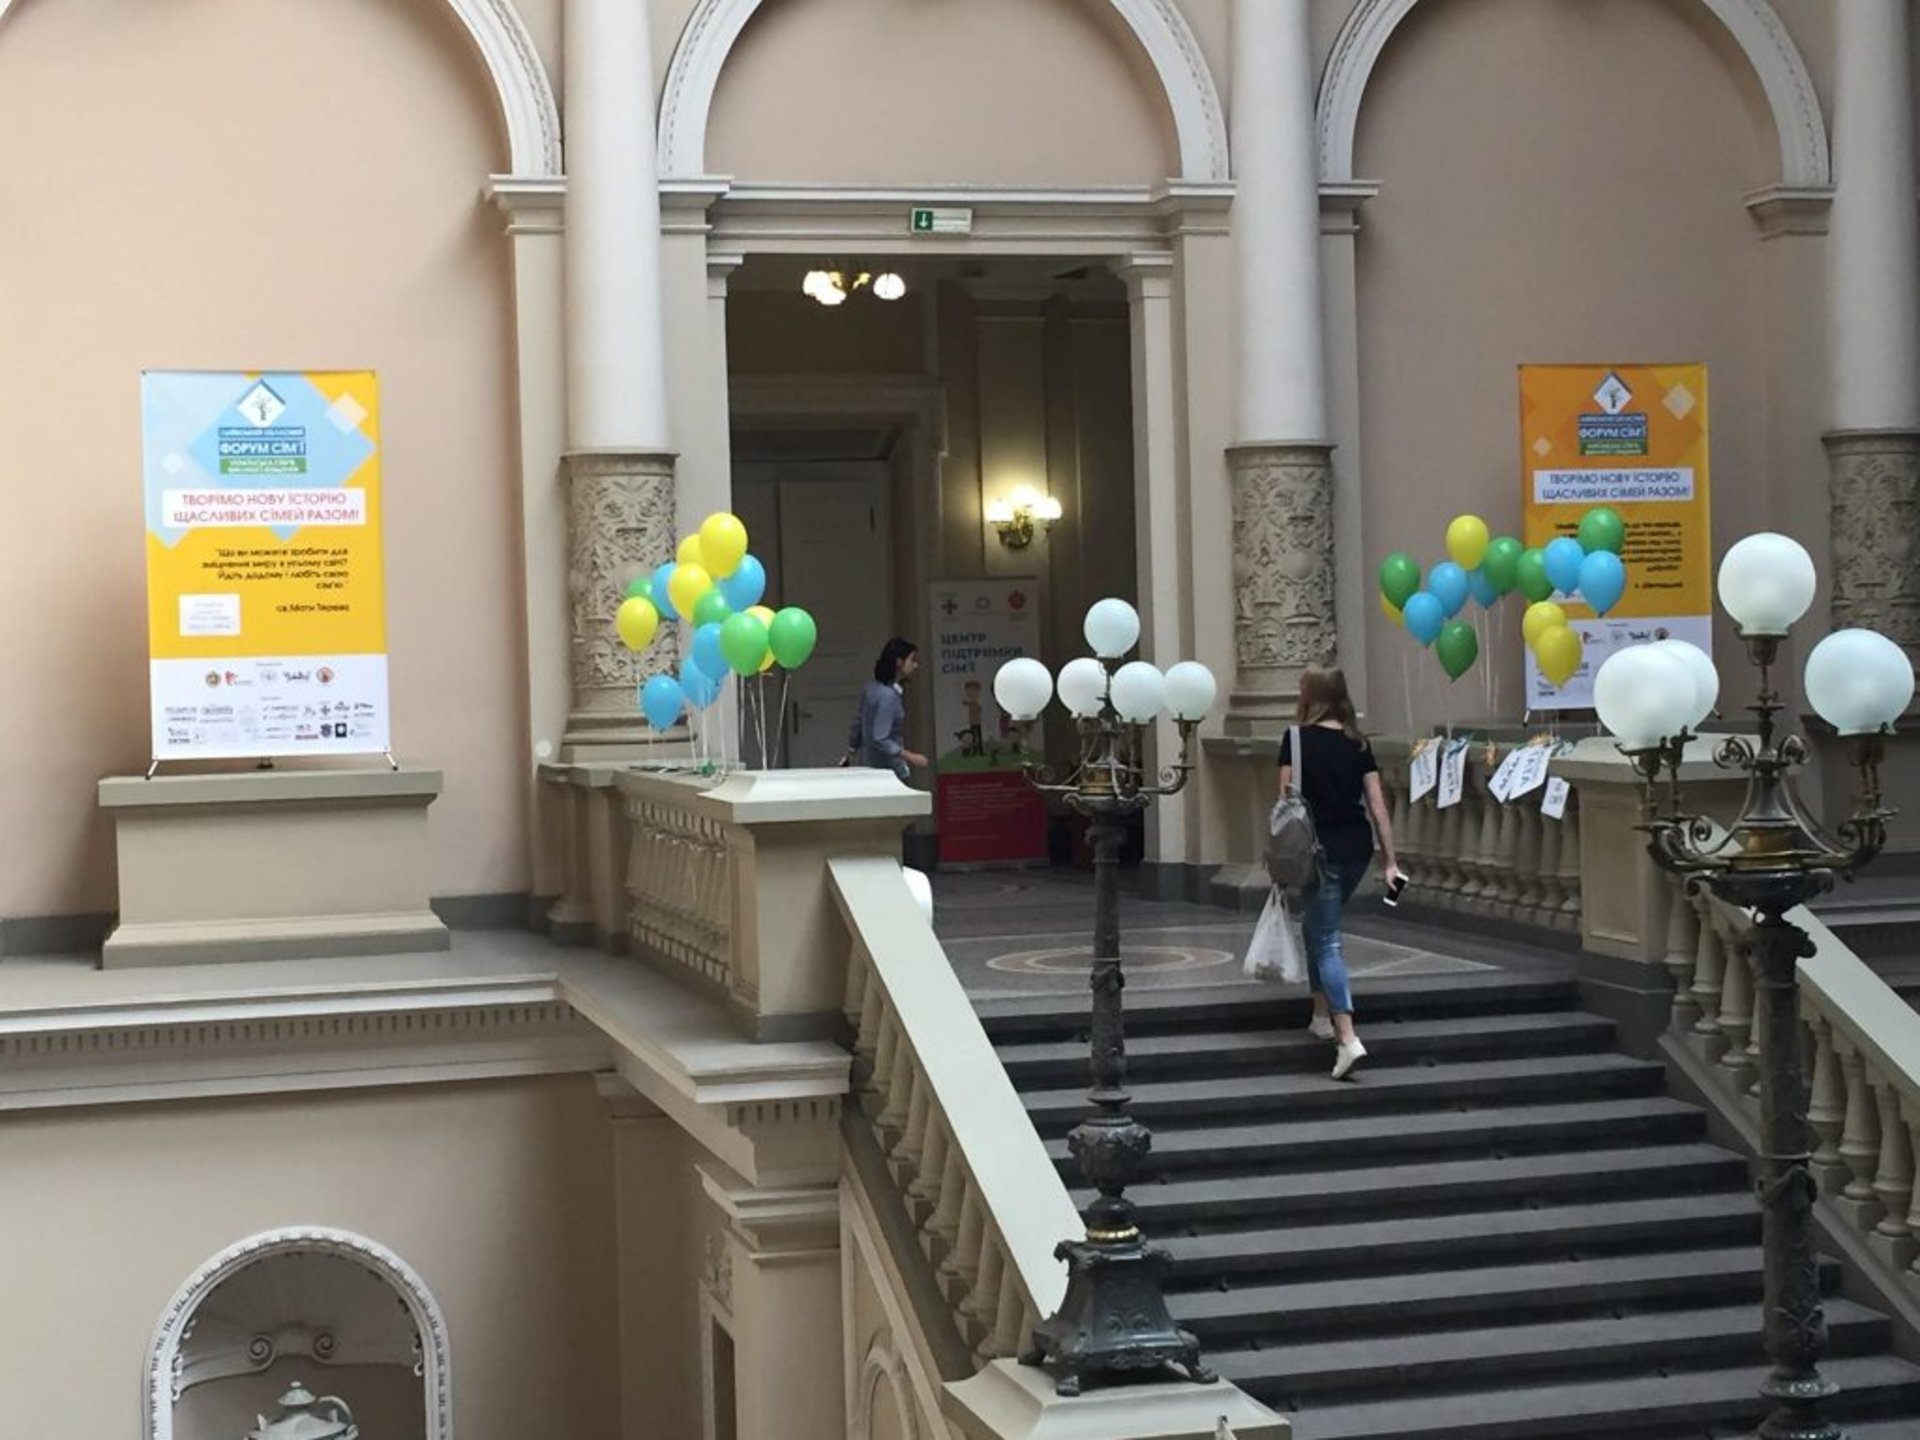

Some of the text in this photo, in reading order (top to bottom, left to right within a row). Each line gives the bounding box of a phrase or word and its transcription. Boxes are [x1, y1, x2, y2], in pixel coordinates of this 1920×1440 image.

[220, 442, 269, 454] ФОРУМ
[1550, 471, 1680, 485] ТВОРІМО НОВУ ІСТОРІЮ
[182, 492, 347, 506] ТВОРІМО НОВУ ІСТОРІЮ
[1542, 485, 1689, 500] ЩАСЛИВИХ СІМЕЙ РАЗОМ!
[173, 508, 359, 524] ЩАСЛИВИХ СІМЕЙ РАЗОМ!
[941, 632, 987, 646] ЦЕНТР
[941, 646, 1023, 660] ПІДТРИМКИ
